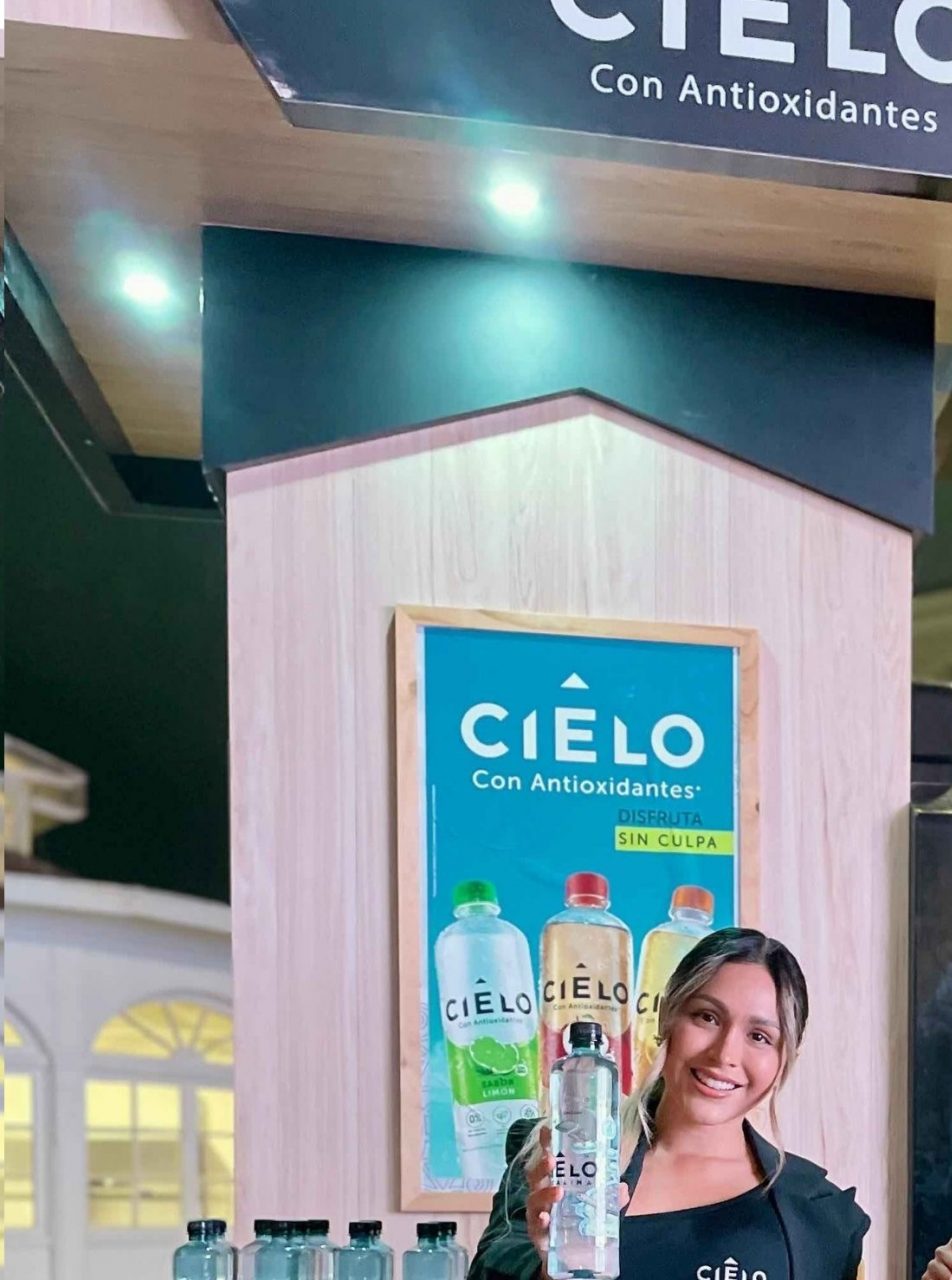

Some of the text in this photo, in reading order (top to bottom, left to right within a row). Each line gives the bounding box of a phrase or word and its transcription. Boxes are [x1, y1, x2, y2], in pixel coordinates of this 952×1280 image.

[590, 64, 938, 134] Con Antioxidantes
[472, 769, 521, 792] Con
[618, 808, 704, 827] DISFRUTA
[618, 832, 717, 849] SIN CULPA
